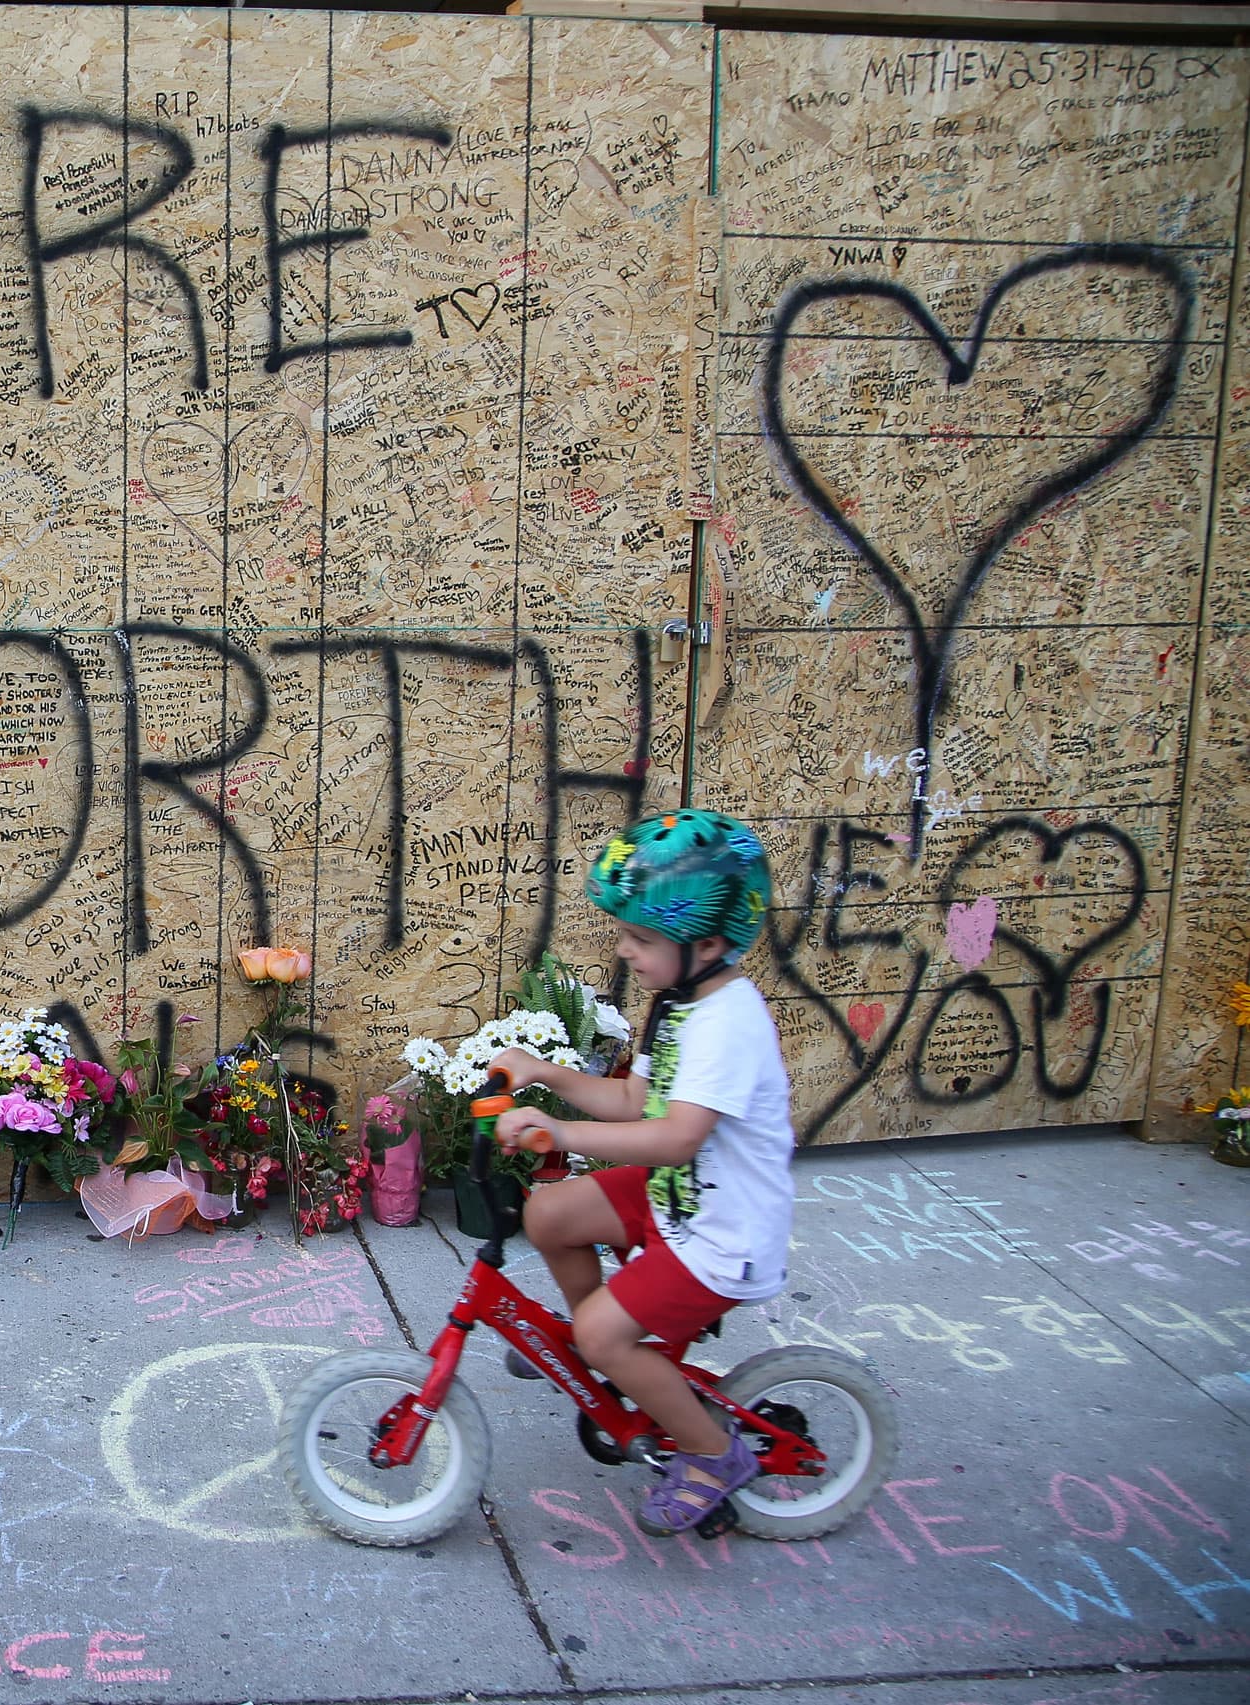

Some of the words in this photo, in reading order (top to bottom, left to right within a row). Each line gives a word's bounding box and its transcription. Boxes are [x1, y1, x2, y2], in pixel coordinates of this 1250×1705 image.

[861, 51, 1006, 94] MATTHEW
[156, 91, 198, 119] RIP
[341, 146, 460, 189] DANNY
[753, 187, 778, 204] THE
[785, 157, 853, 192] STRONGEST
[370, 179, 499, 218] STRONG
[829, 246, 884, 265] YNWA
[881, 410, 930, 429] LOVE
[300, 608, 323, 620] RIP
[6, 689, 62, 700] SHOOTER'S
[15, 704, 36, 713] FOR
[40, 703, 56, 712] HIS
[1, 720, 34, 730] WHICH
[40, 717, 64, 726] NOW
[31, 733, 56, 742] THIS
[0, 747, 39, 757] THEM
[149, 806, 180, 822] WE
[151, 825, 184, 836] THE
[150, 841, 224, 856] DANFORTH
[420, 827, 470, 863] MAY
[471, 823, 510, 846] WE
[427, 859, 493, 888] STAND
[497, 857, 517, 873] IN
[521, 856, 575, 875] LOVE
[460, 883, 539, 906] PEACE
[162, 958, 183, 970] We
[376, 934, 429, 980] neighbor
[159, 975, 217, 988] Danforth
[361, 995, 396, 1014] Stay
[366, 1025, 409, 1036] strong
[780, 948, 1112, 1147] YOU
[834, 1227, 1060, 1265] HATE
